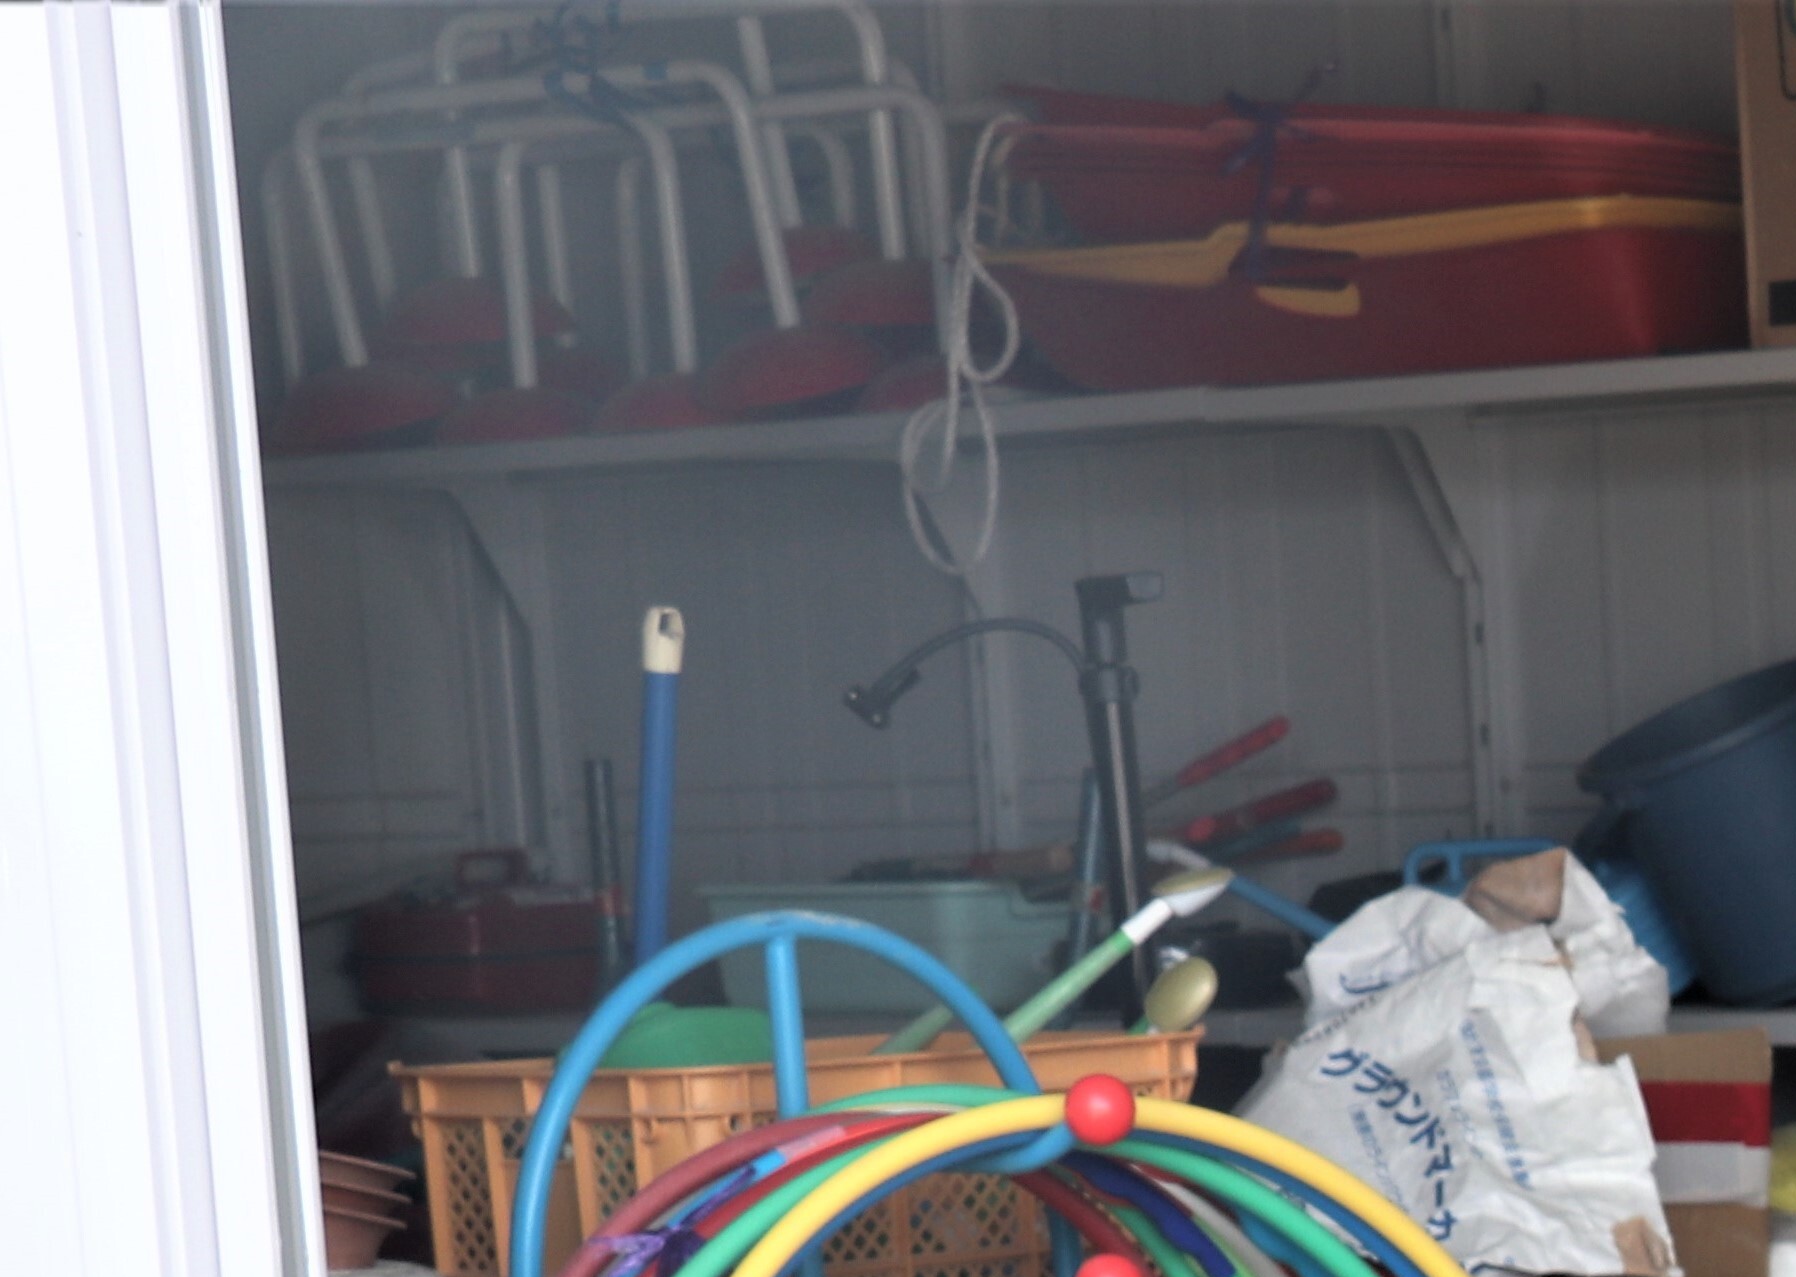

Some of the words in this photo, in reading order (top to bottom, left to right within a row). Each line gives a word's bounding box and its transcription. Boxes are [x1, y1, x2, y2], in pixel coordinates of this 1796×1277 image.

[1321, 1048, 1459, 1245] グラウンドマーカ
